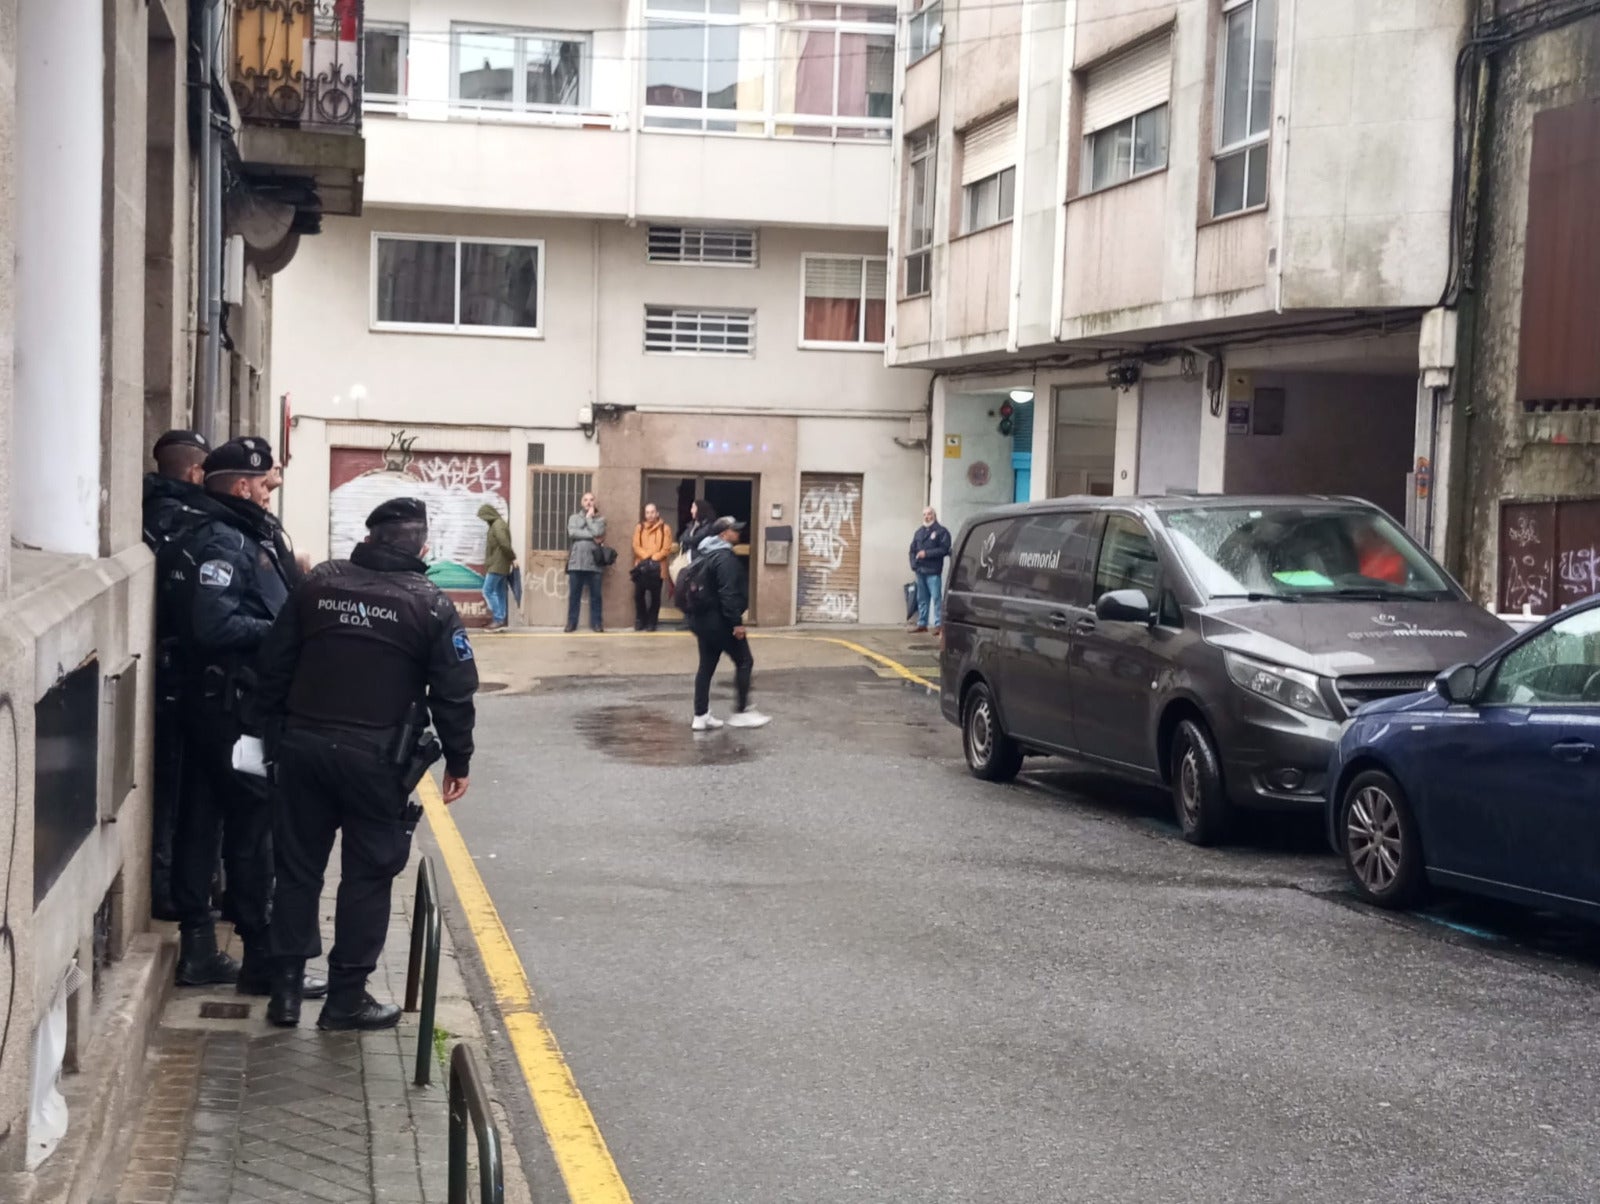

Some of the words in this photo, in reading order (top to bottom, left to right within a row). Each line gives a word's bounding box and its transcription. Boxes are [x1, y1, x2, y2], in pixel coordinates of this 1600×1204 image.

[1019, 549, 1061, 570] memorial
[317, 599, 358, 614] POLICÍA
[366, 605, 399, 623] LOCAL
